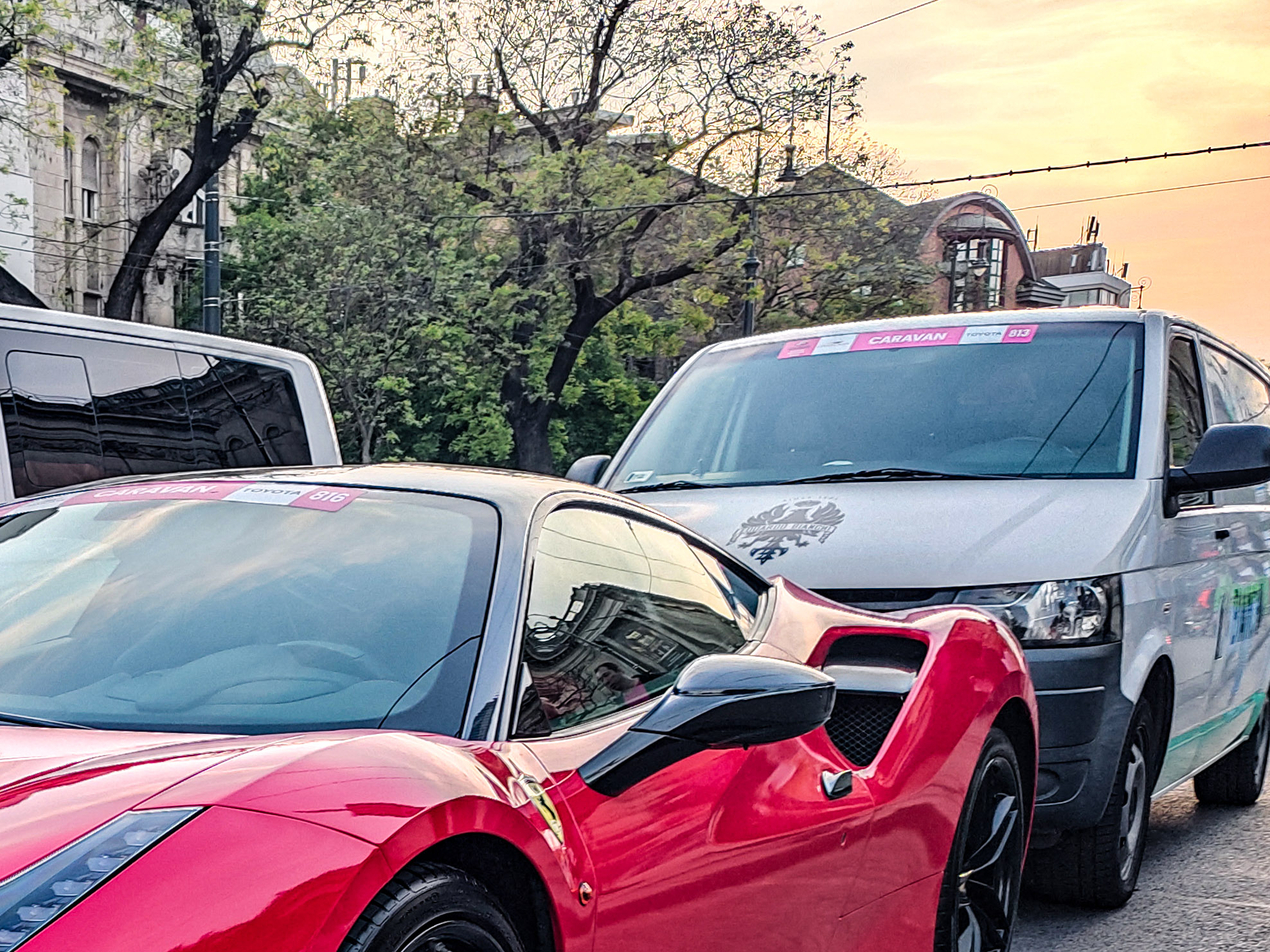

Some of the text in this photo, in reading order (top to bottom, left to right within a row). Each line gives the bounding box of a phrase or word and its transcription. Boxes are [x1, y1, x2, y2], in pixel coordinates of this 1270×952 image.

[868, 332, 948, 345] CARAVAN
[1008, 328, 1031, 338] 813
[93, 485, 215, 498] CARAVAN
[243, 488, 302, 496] TOYOTA
[309, 490, 349, 503] 816
